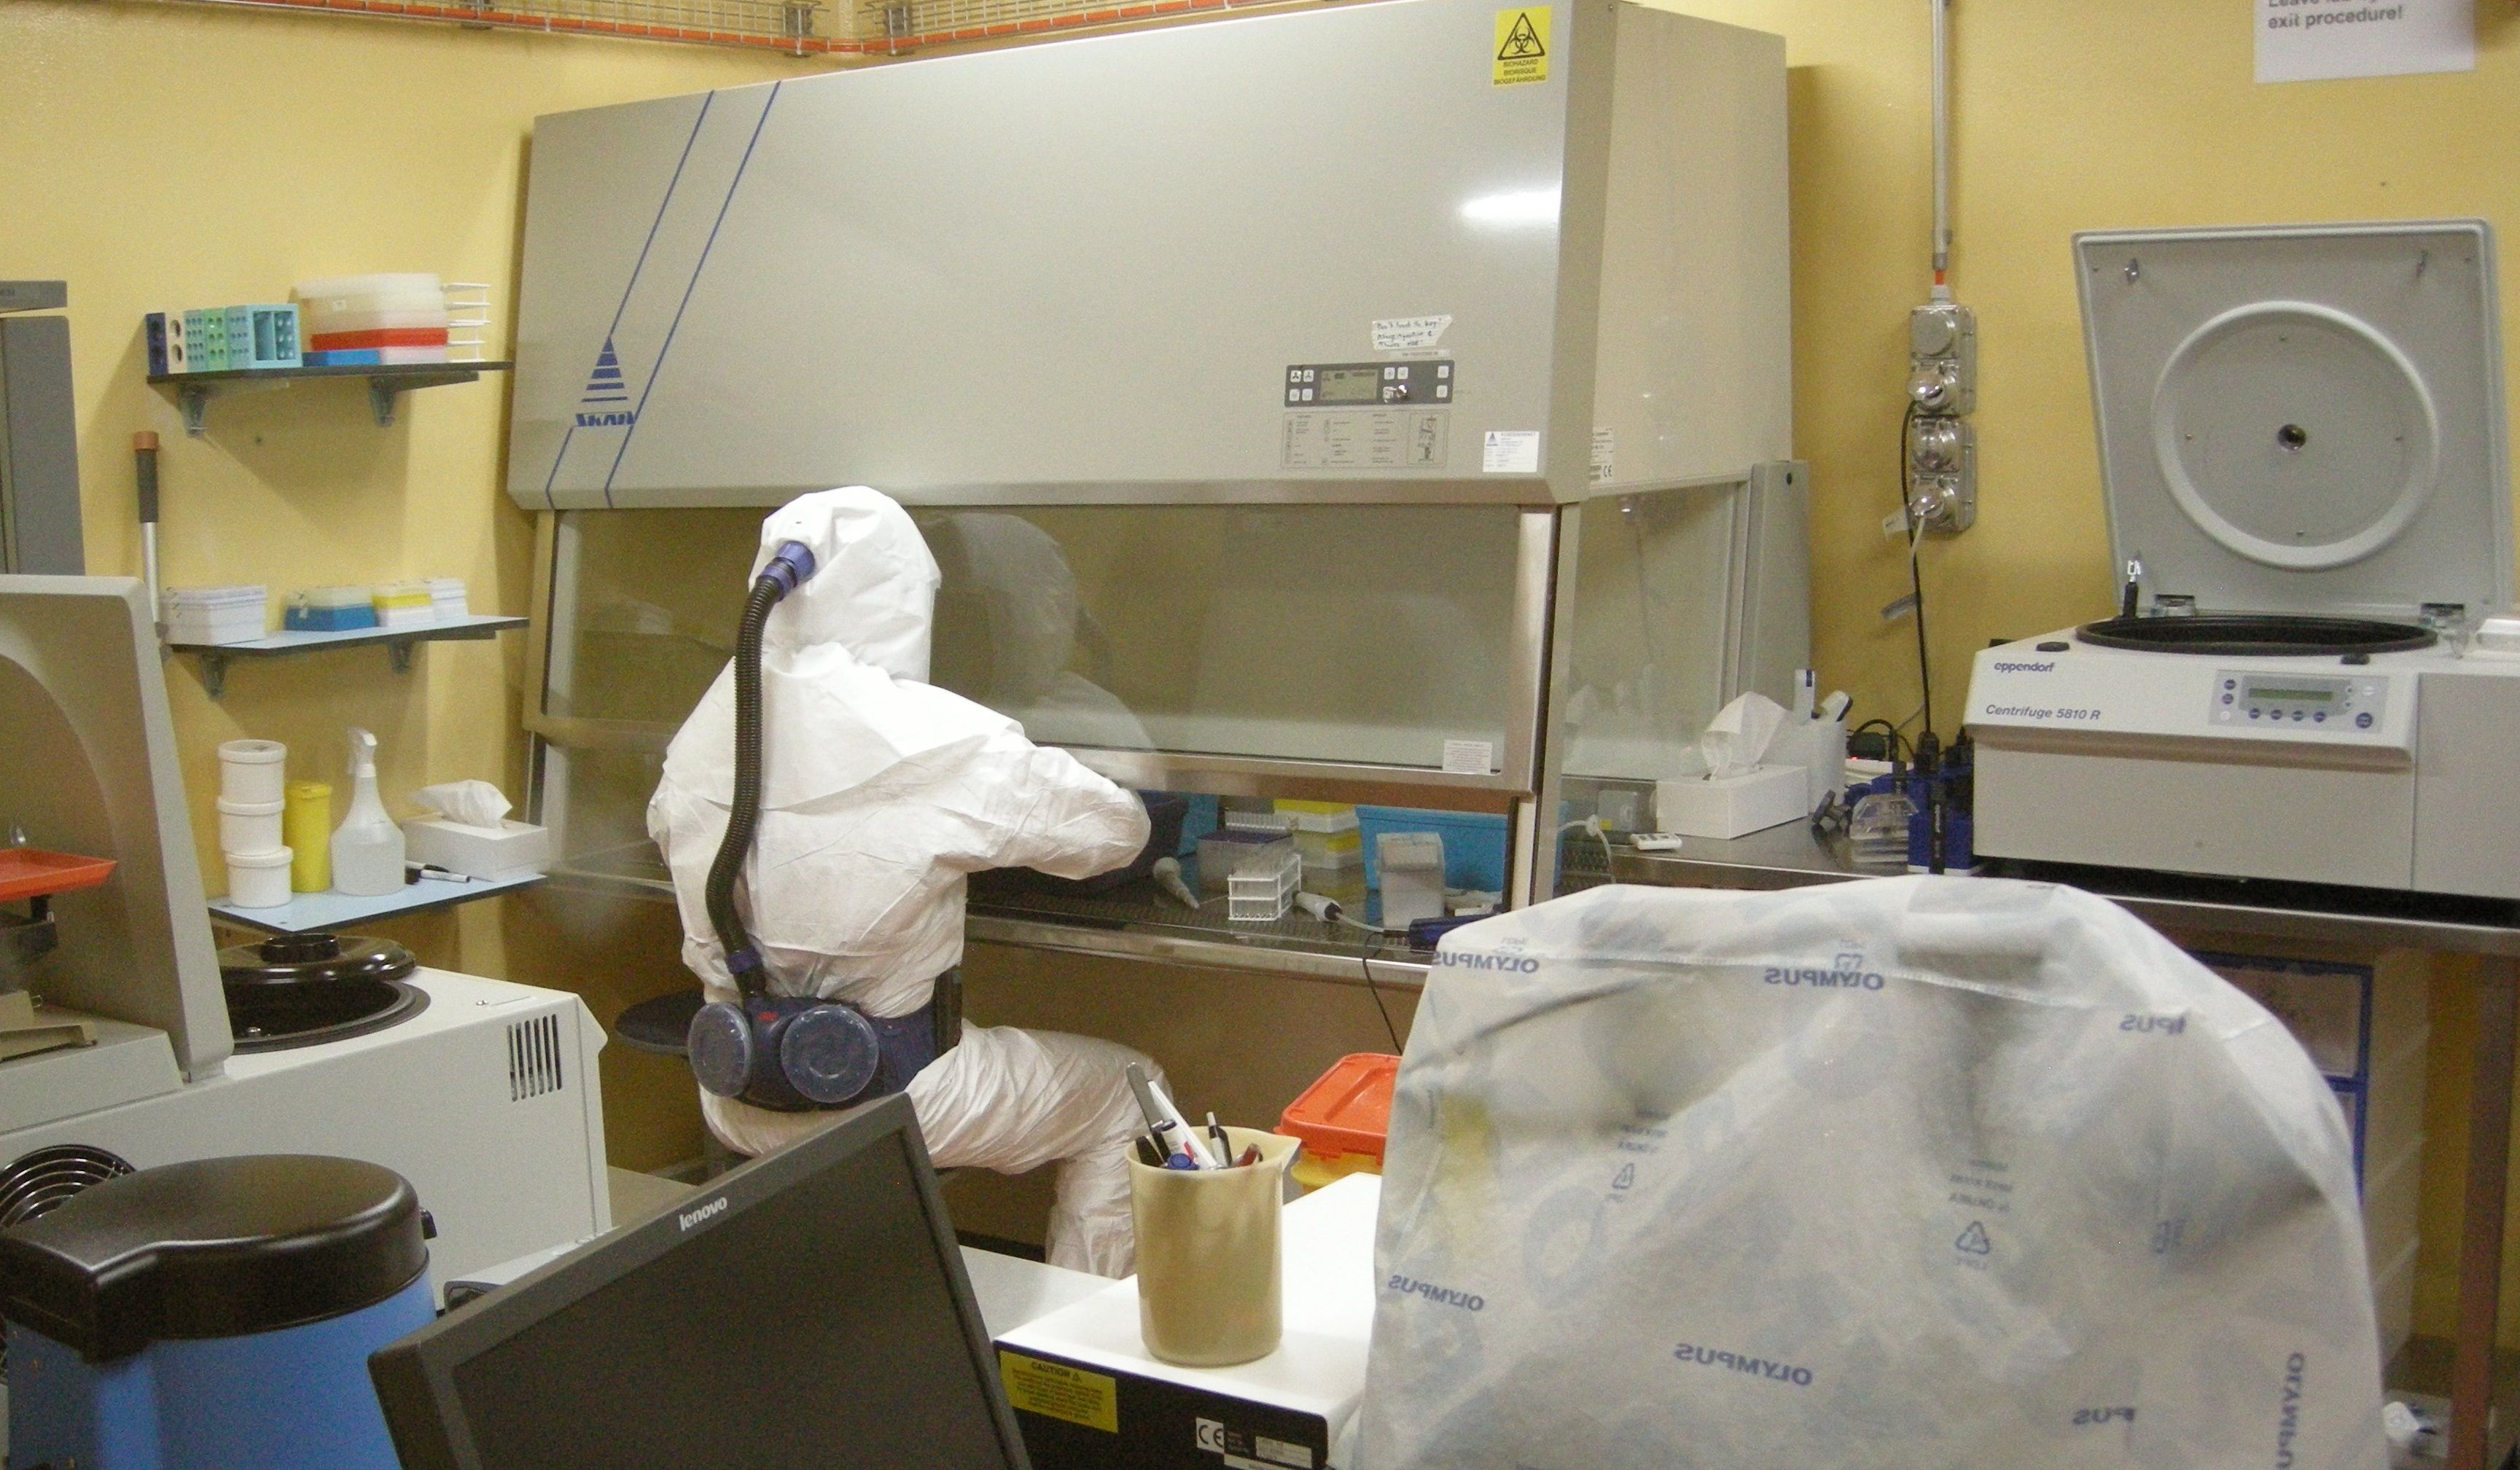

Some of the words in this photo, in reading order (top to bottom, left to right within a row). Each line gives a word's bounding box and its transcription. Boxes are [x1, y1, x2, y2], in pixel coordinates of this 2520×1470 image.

[2268, 13, 2299, 29] exit
[2305, 5, 2403, 29] procedure!
[1994, 662, 2055, 673] eppendorf
[1986, 704, 2053, 719] Centrifuge
[2056, 708, 2087, 719] 5810
[2090, 710, 2101, 719] R
[679, 1197, 727, 1232] lenovo
